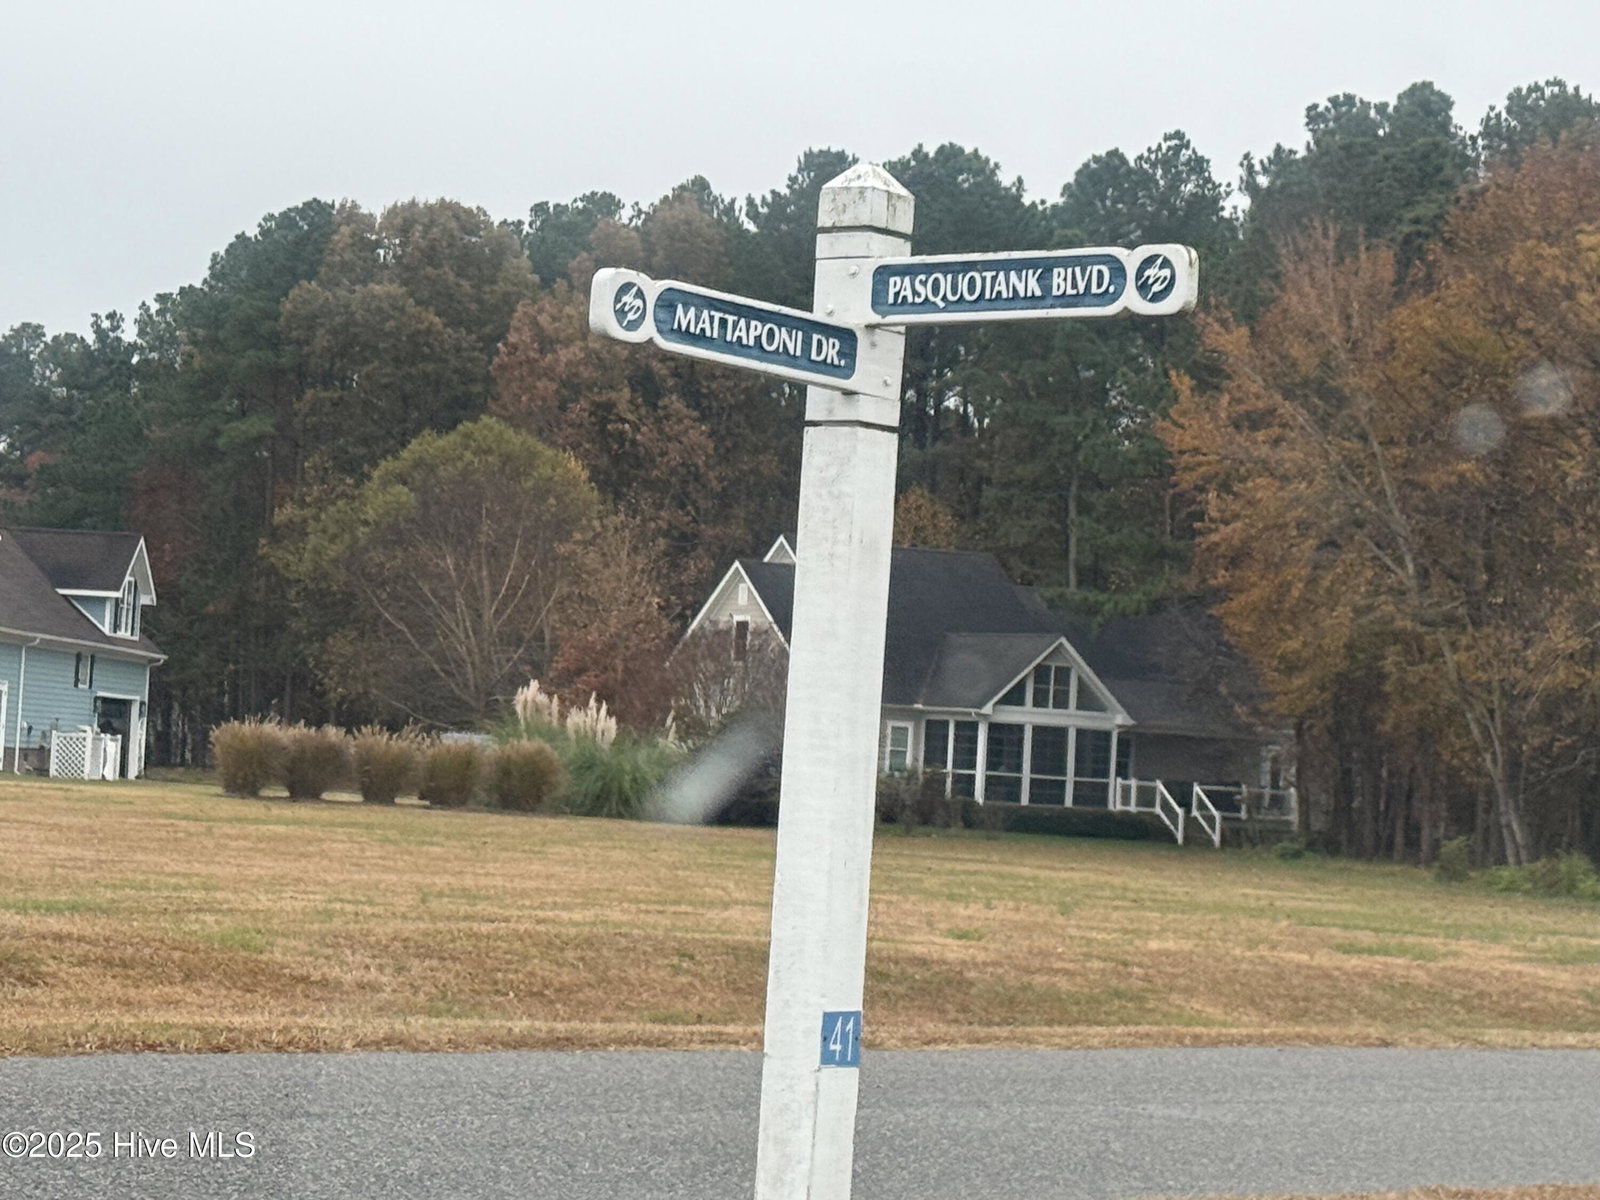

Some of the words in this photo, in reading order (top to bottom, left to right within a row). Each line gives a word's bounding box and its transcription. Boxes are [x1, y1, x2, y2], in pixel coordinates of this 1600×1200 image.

[888, 268, 1043, 309] PASQUOTANK
[1052, 264, 1115, 297] BLVD.
[673, 303, 802, 357] MATTAPONI
[810, 333, 846, 367] DR.
[829, 1016, 854, 1062] 41
